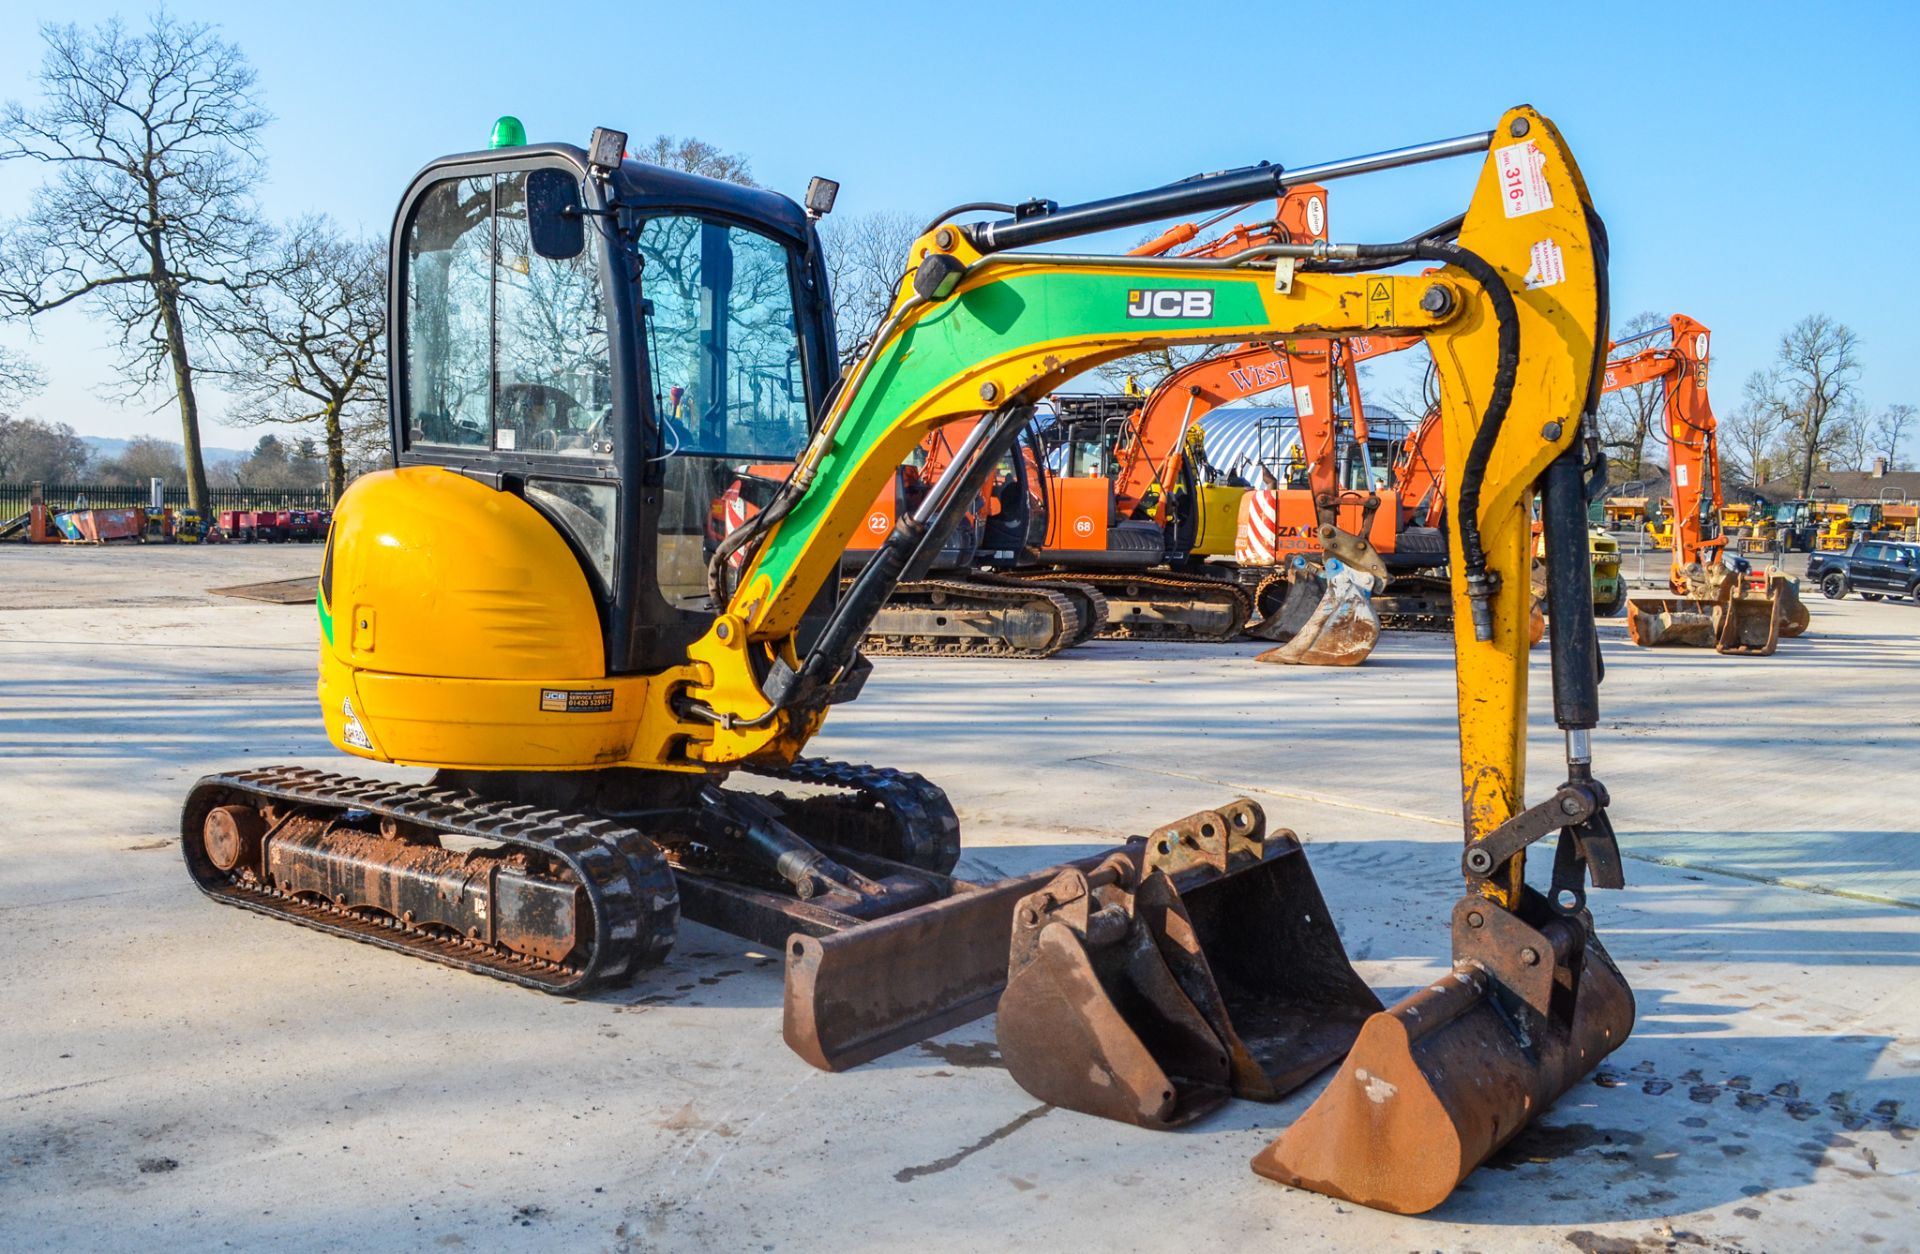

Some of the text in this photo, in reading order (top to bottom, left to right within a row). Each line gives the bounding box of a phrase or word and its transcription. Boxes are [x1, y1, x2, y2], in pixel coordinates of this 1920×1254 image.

[1506, 168, 1525, 200] 316
[1128, 291, 1212, 317] JCB
[871, 517, 885, 529] 22
[1076, 521, 1091, 532] 68
[1278, 523, 1319, 538] ZAXIS
